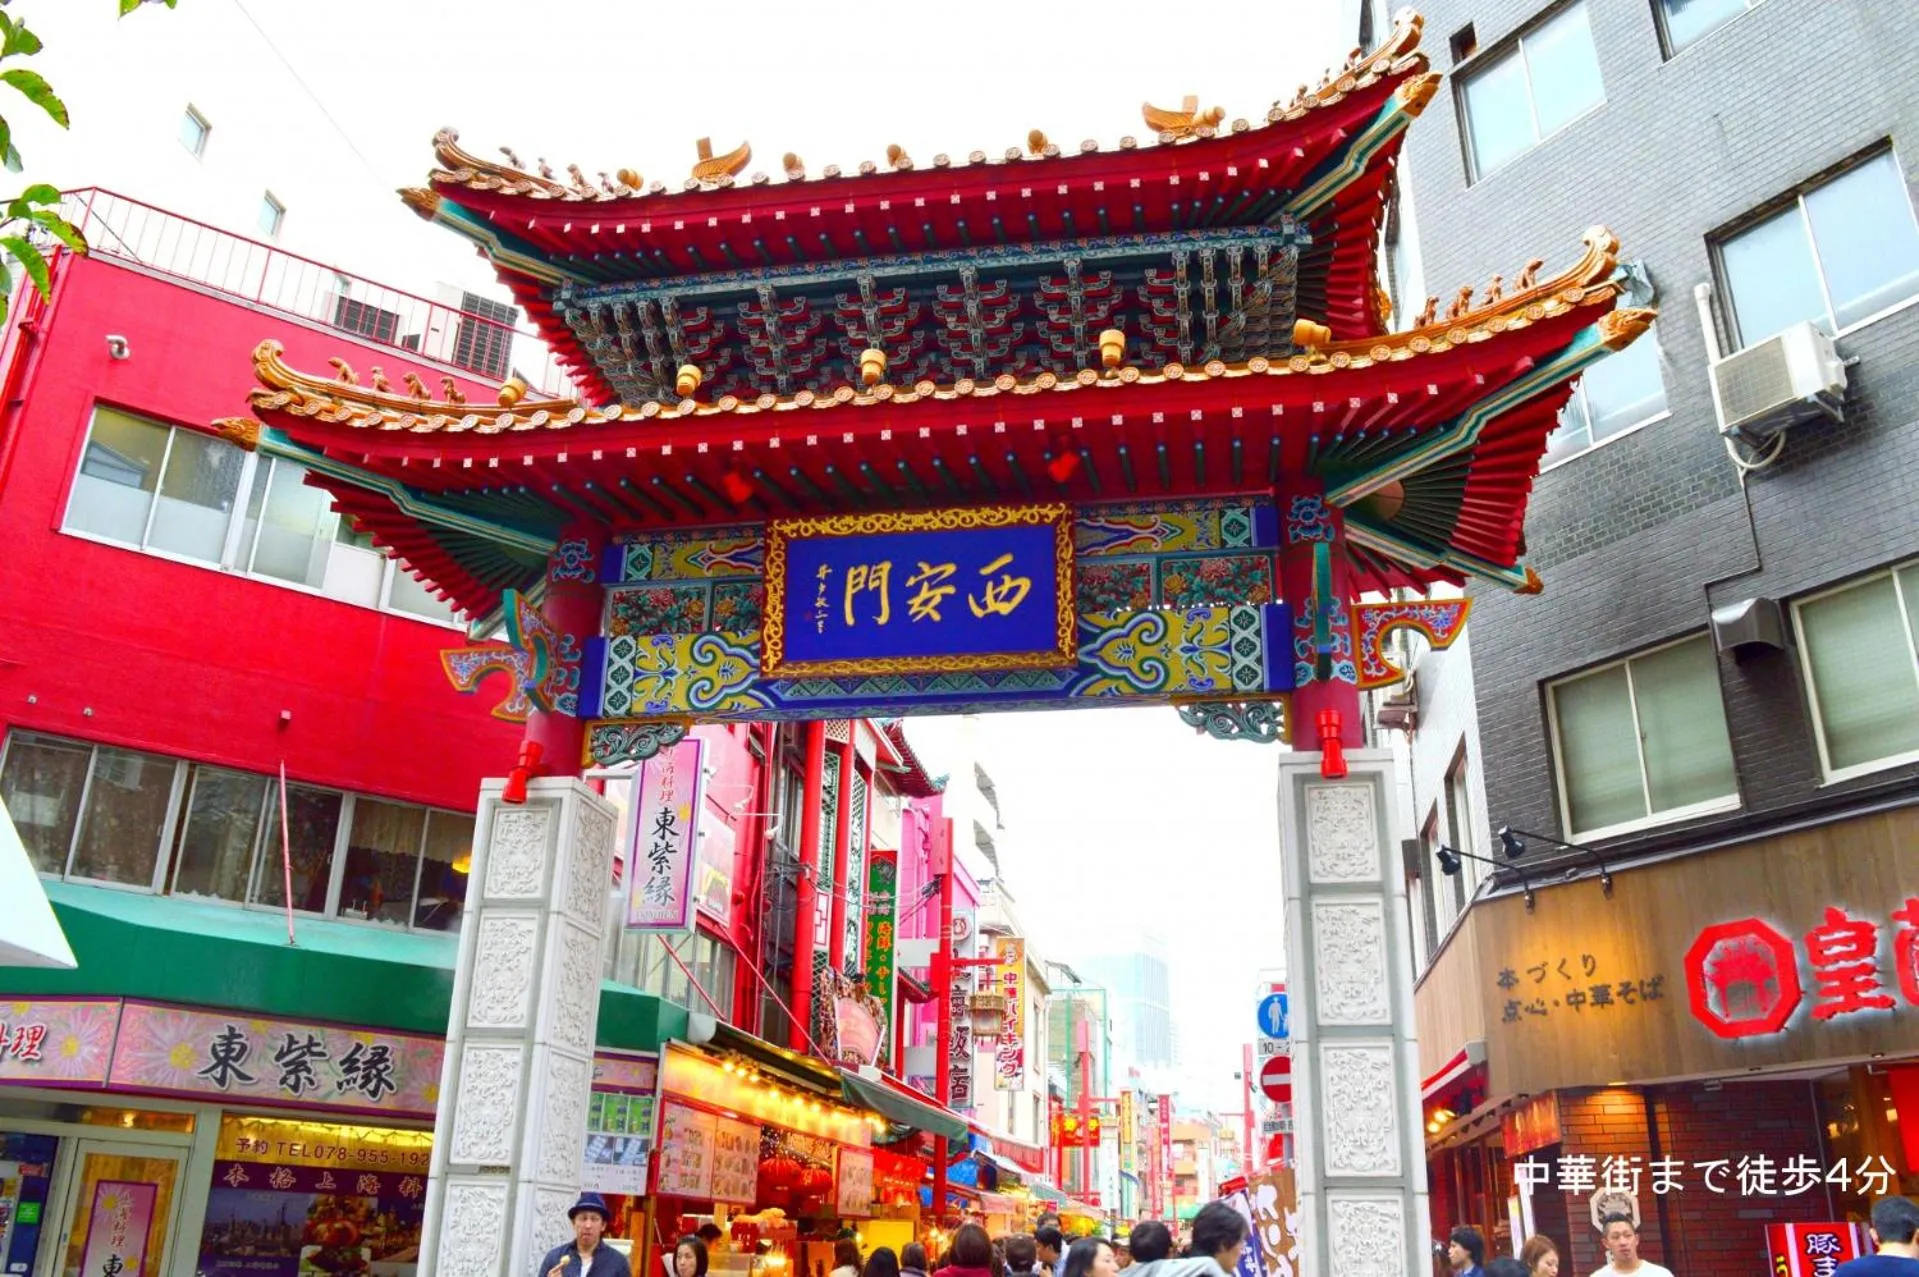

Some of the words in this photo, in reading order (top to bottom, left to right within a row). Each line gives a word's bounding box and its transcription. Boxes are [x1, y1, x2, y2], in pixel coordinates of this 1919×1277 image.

[646, 806, 680, 906] 東紫縁
[1497, 954, 1597, 990] 本づくり
[1501, 974, 1664, 1023] 点心・中華そば
[199, 1023, 396, 1099] 東紫縁
[235, 1137, 268, 1156] 予約
